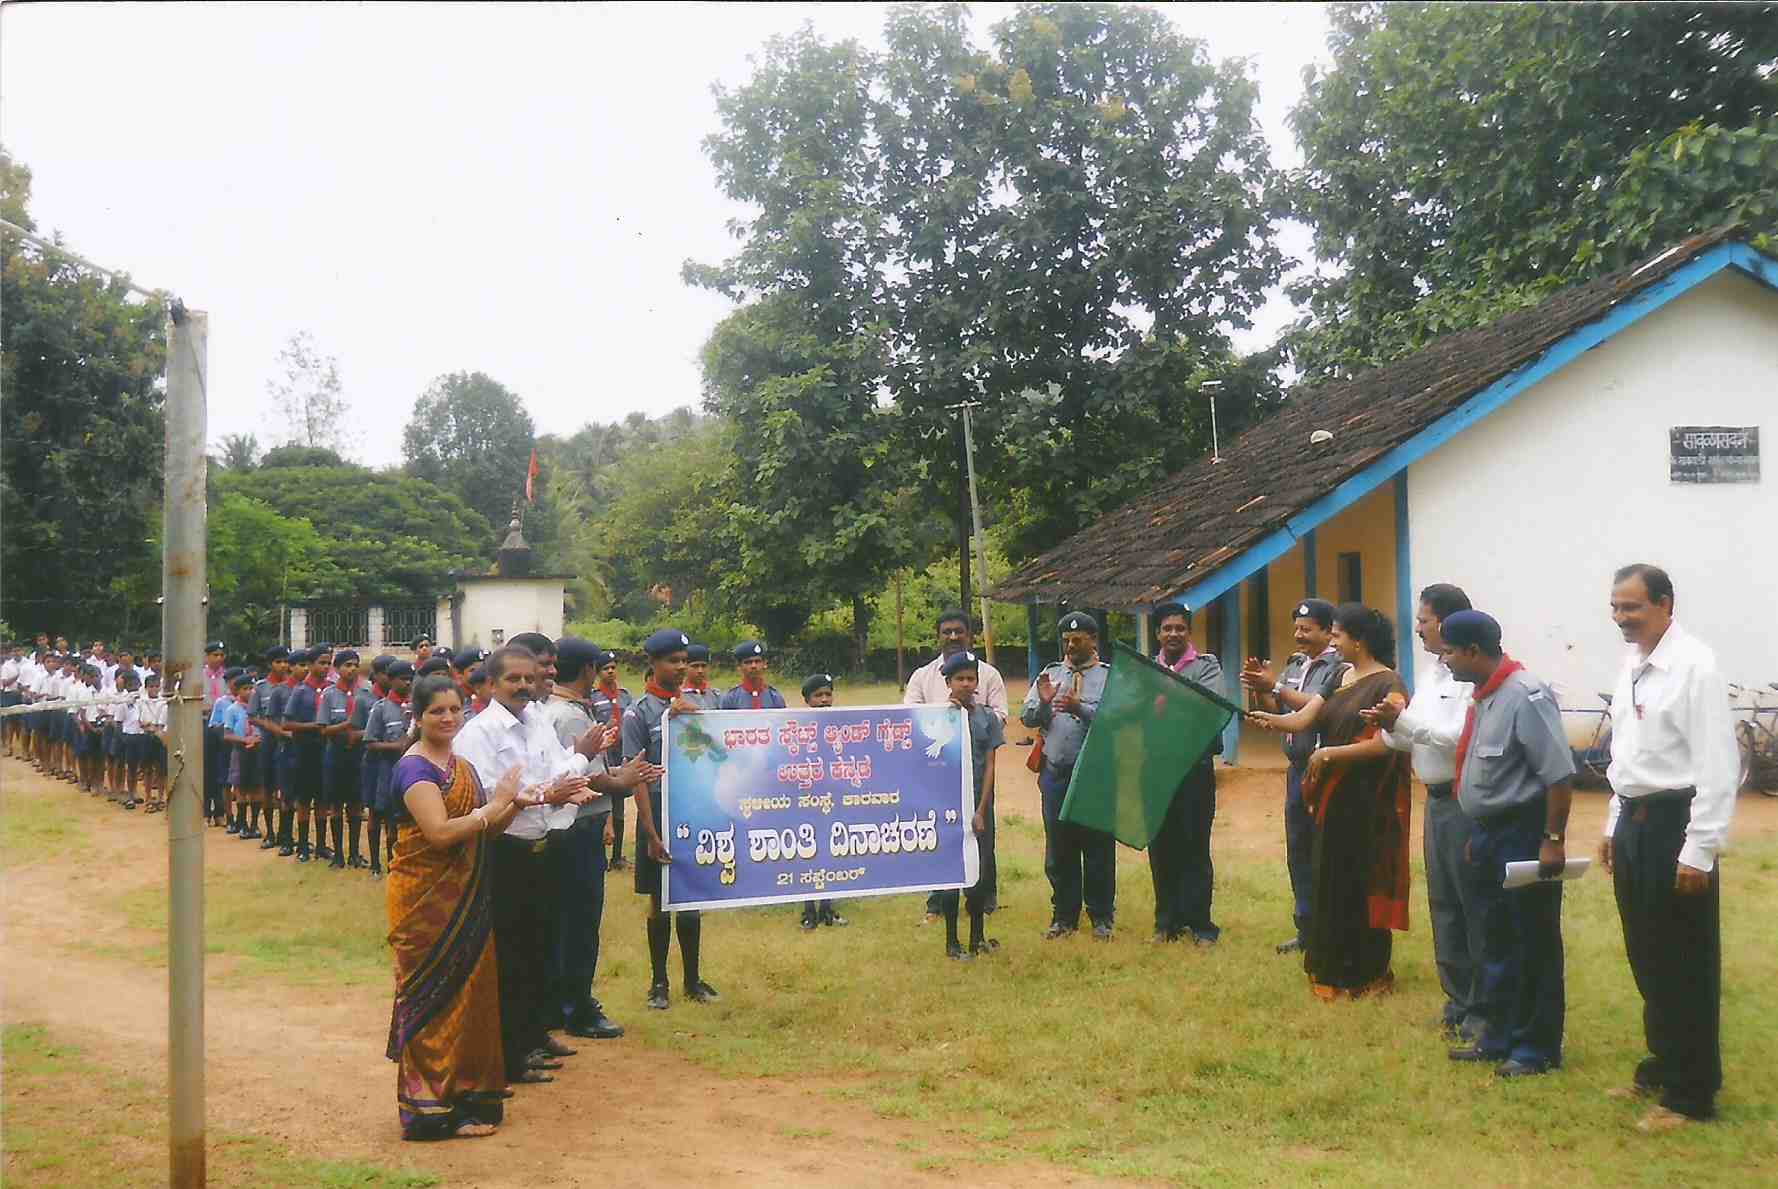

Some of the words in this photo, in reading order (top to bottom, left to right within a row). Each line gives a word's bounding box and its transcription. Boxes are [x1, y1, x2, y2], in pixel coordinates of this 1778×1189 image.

[724, 728, 772, 750] ಭಾರತ
[778, 756, 825, 789] ಉತ್ತರ
[830, 755, 872, 787] ಕನ್ನಡ
[842, 790, 901, 807] ಕಾರವಾರ
[695, 823, 736, 885] ವಿಶ್ವ
[748, 823, 818, 862] ಶಾಂತಿ
[830, 809, 938, 857] ದಿನಾಚರಣೆ
[777, 872, 793, 885] 21
